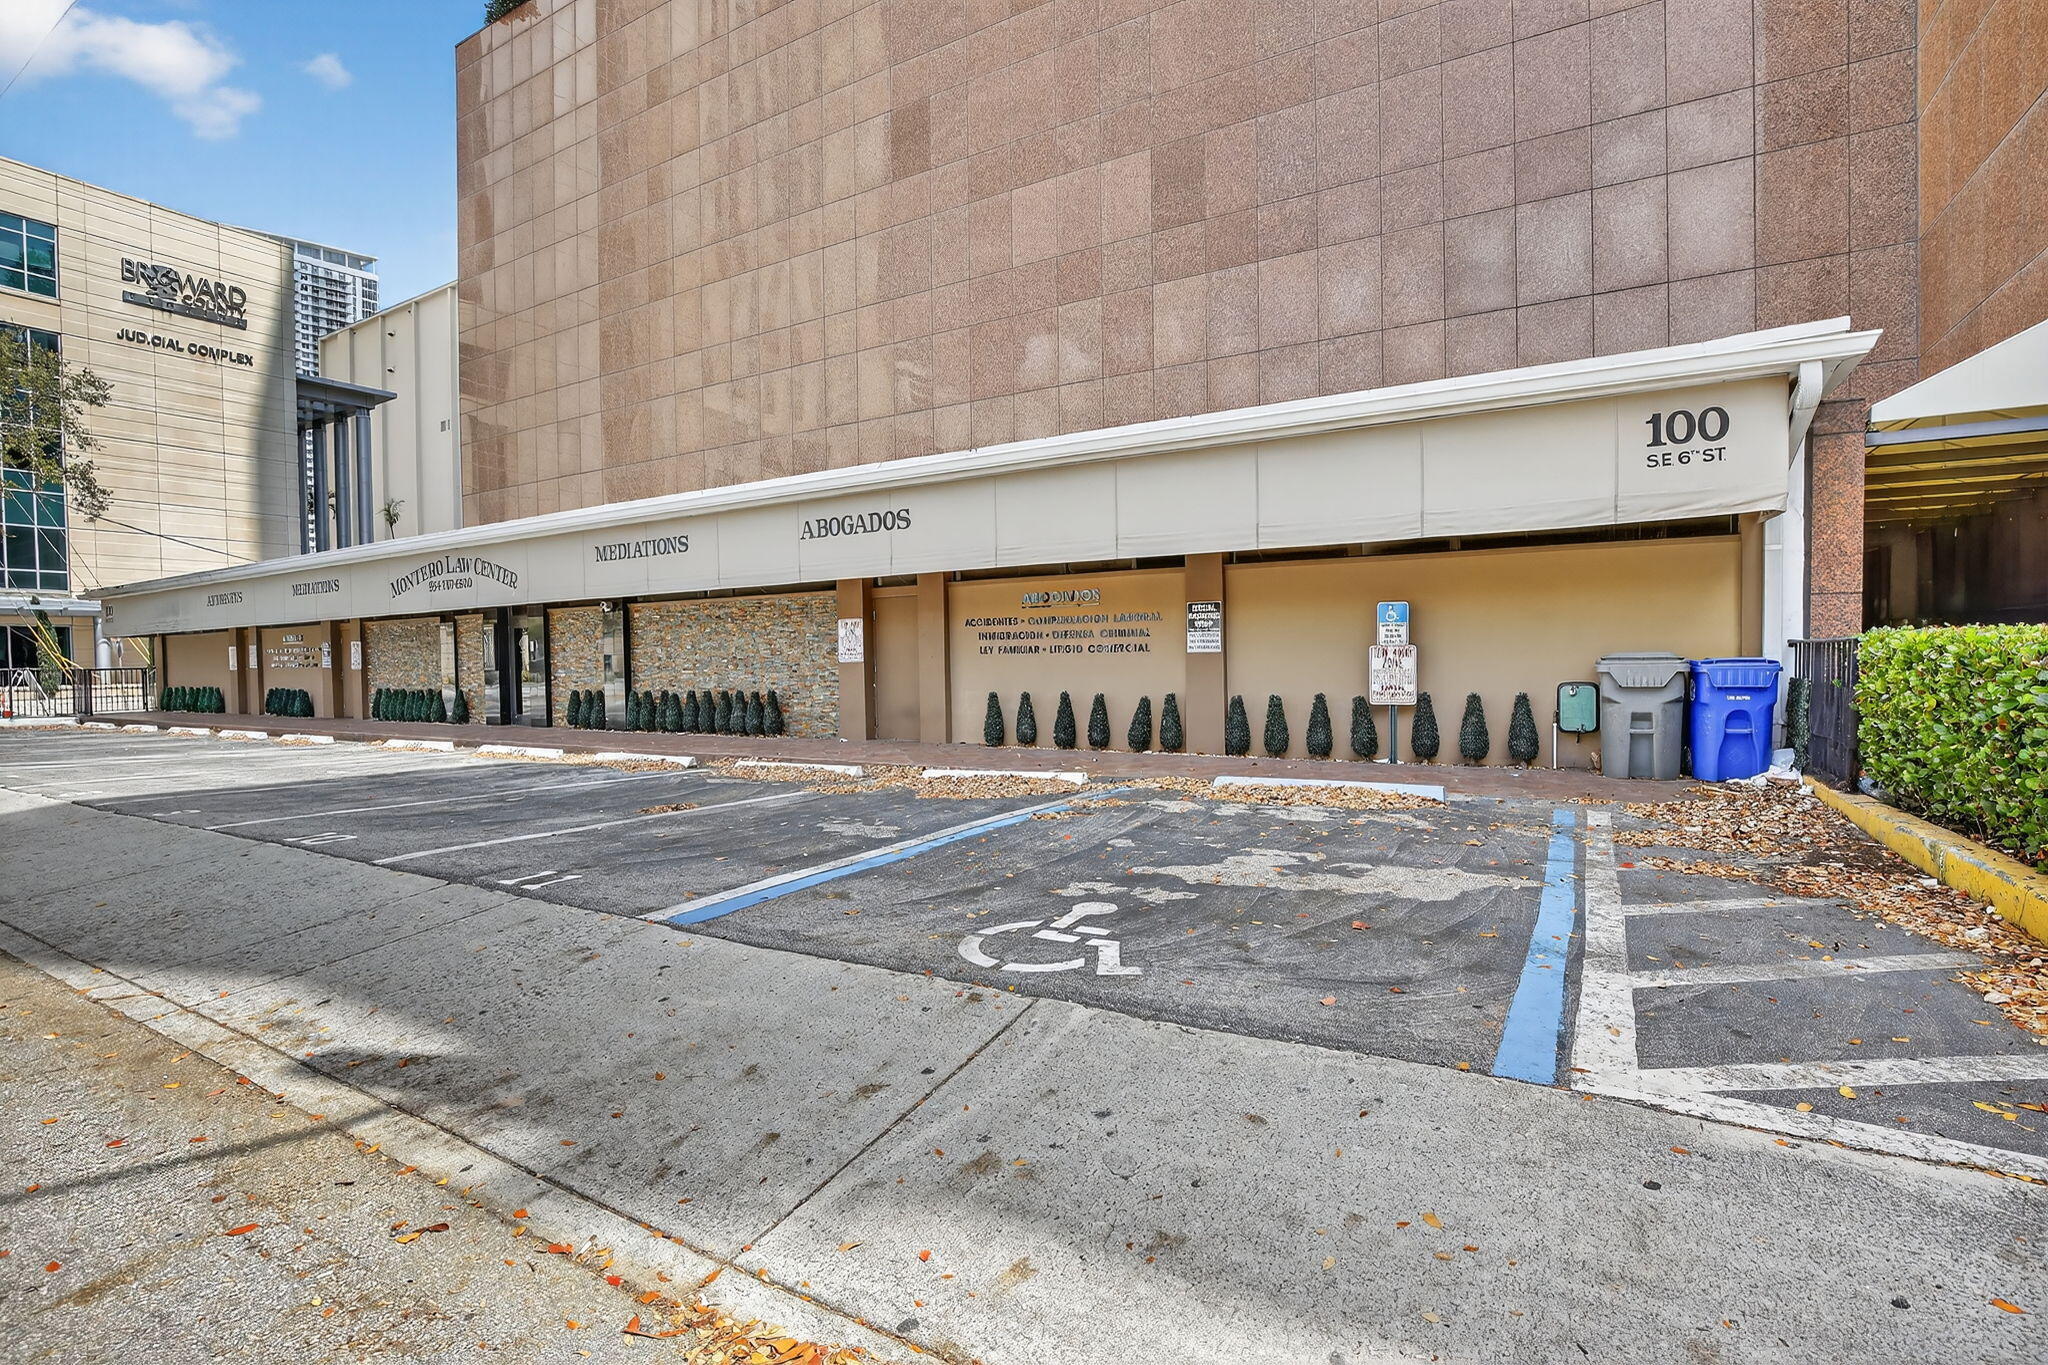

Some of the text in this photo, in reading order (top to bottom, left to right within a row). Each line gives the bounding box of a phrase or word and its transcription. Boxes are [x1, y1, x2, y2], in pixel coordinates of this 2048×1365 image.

[117, 328, 253, 366] JUDICIAL COMPLEX
[1645, 406, 1730, 447] 100
[800, 508, 912, 540] ABOGADOS
[594, 535, 689, 562] MEDIATIONS
[390, 556, 518, 598] MONTERO LAW CENTER
[965, 617, 1018, 627] ACCIDENTES
[979, 645, 994, 655] LEY
[1088, 643, 1151, 653] COMERCIAL
